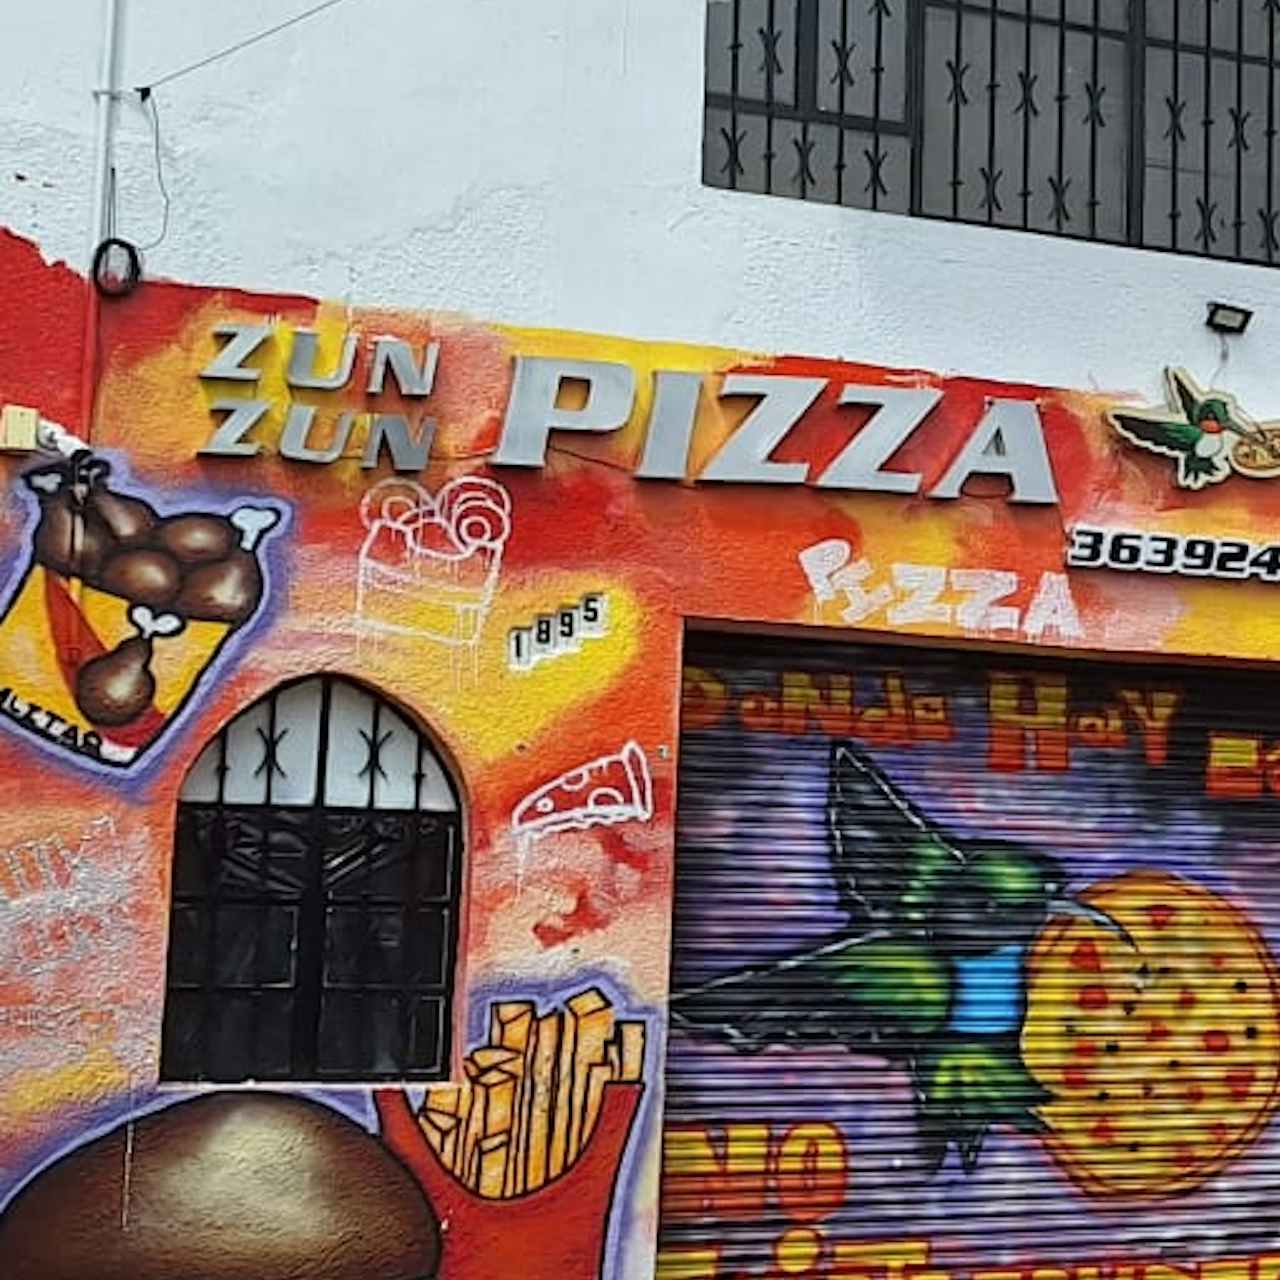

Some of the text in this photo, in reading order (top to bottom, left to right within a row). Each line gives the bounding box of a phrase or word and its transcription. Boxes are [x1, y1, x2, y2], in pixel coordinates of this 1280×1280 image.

[200, 321, 440, 396] ZUN
[197, 399, 438, 470] ZUN
[490, 355, 1060, 504] PIZZA
[513, 596, 600, 660] 1895
